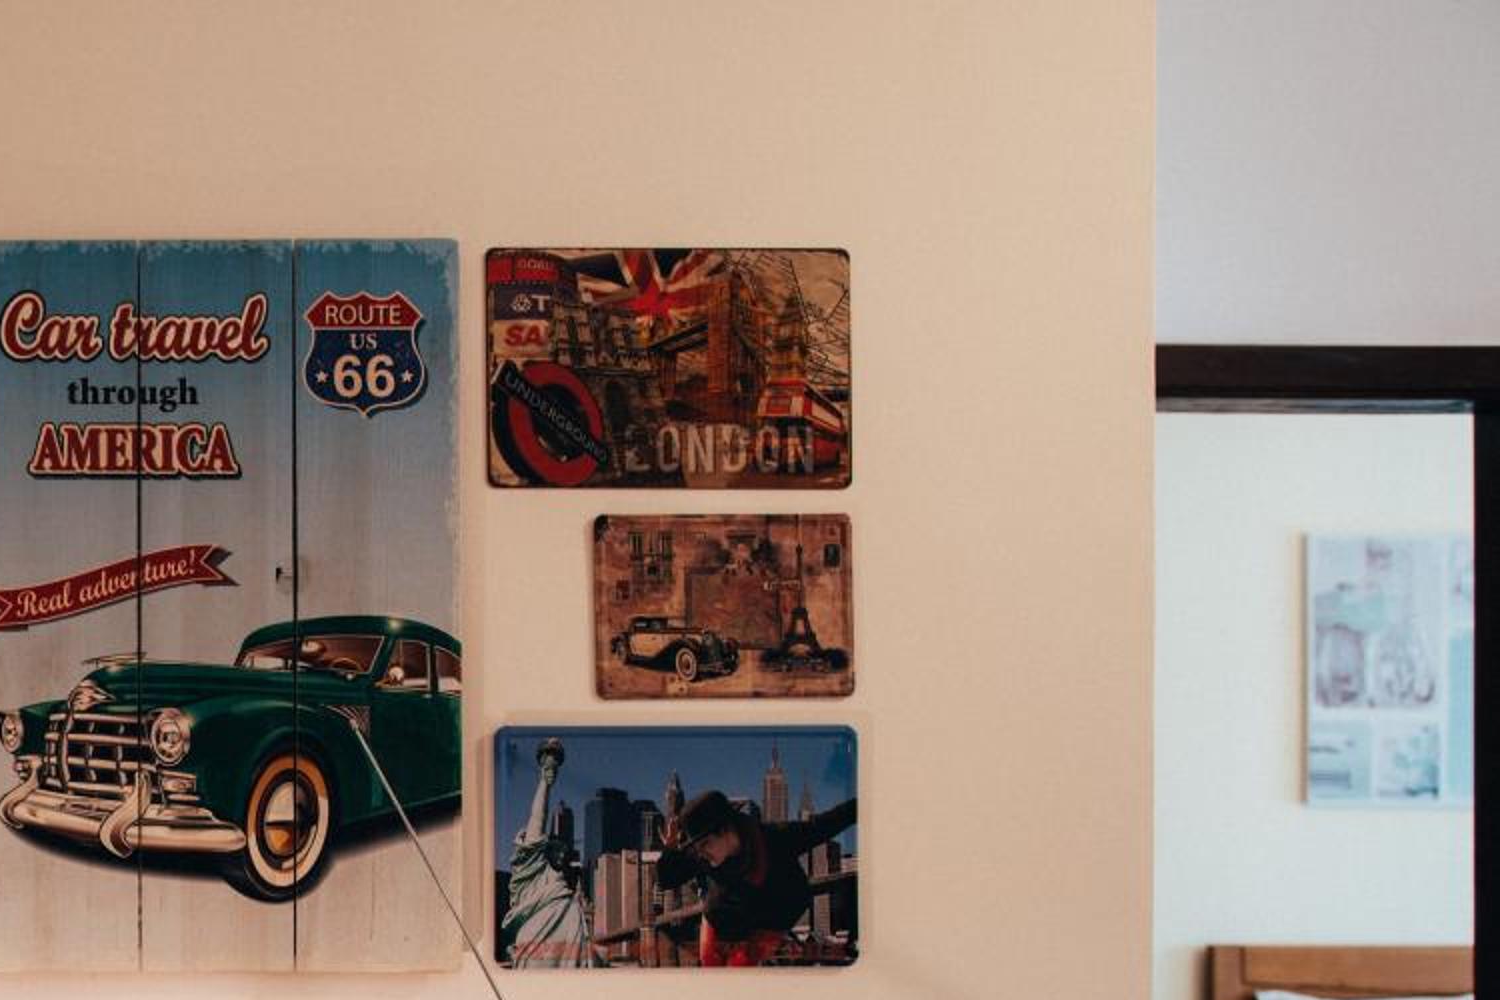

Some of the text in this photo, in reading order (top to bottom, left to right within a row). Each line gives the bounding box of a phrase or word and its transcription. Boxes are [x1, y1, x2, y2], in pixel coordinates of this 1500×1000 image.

[1, 291, 270, 361] Car travel
[324, 305, 402, 326] ROUTE
[349, 333, 378, 350] US
[67, 376, 199, 411] through
[332, 354, 396, 398] 66
[30, 423, 242, 478] AMERICA
[624, 423, 815, 474] LONDON
[15, 551, 197, 620] Real adventure!
